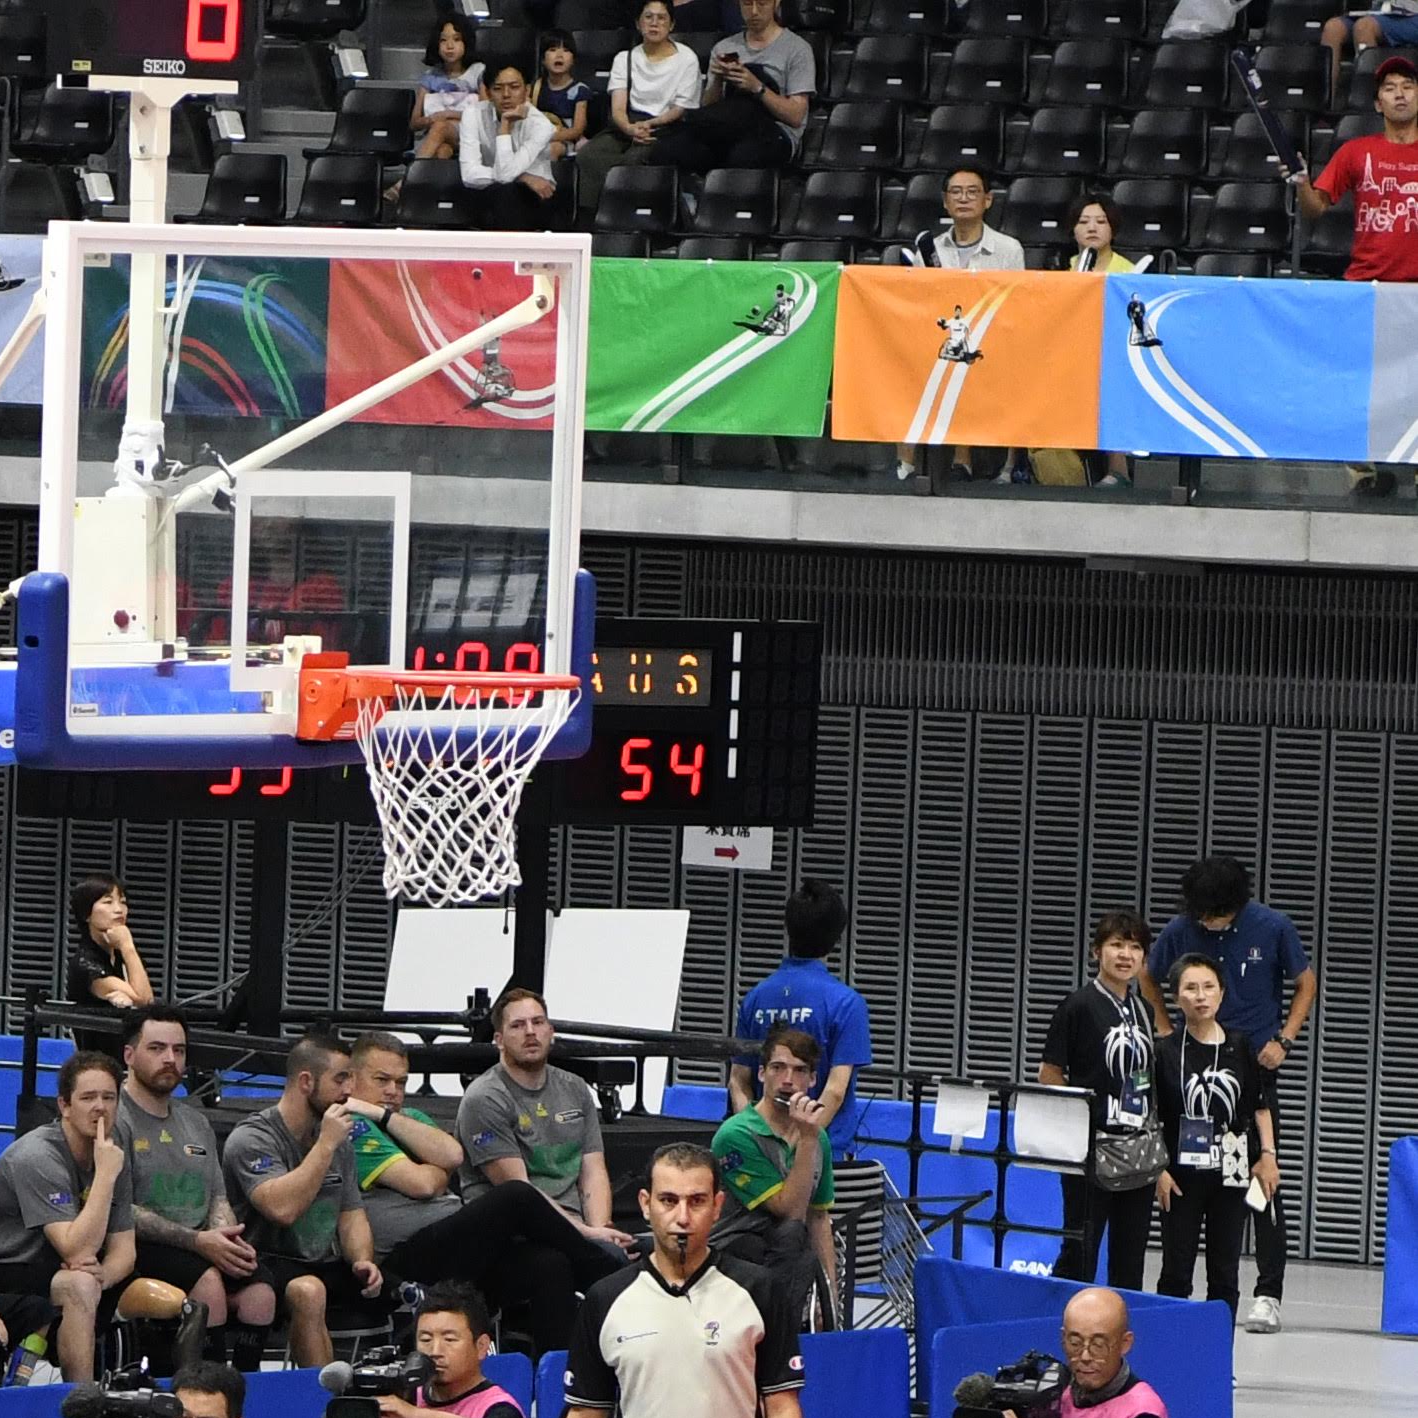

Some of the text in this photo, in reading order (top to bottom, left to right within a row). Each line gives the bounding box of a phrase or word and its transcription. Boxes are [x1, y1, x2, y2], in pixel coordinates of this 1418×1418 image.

[143, 59, 186, 75] SEIKO
[620, 738, 705, 800] 54
[754, 1007, 813, 1025] STAFF
